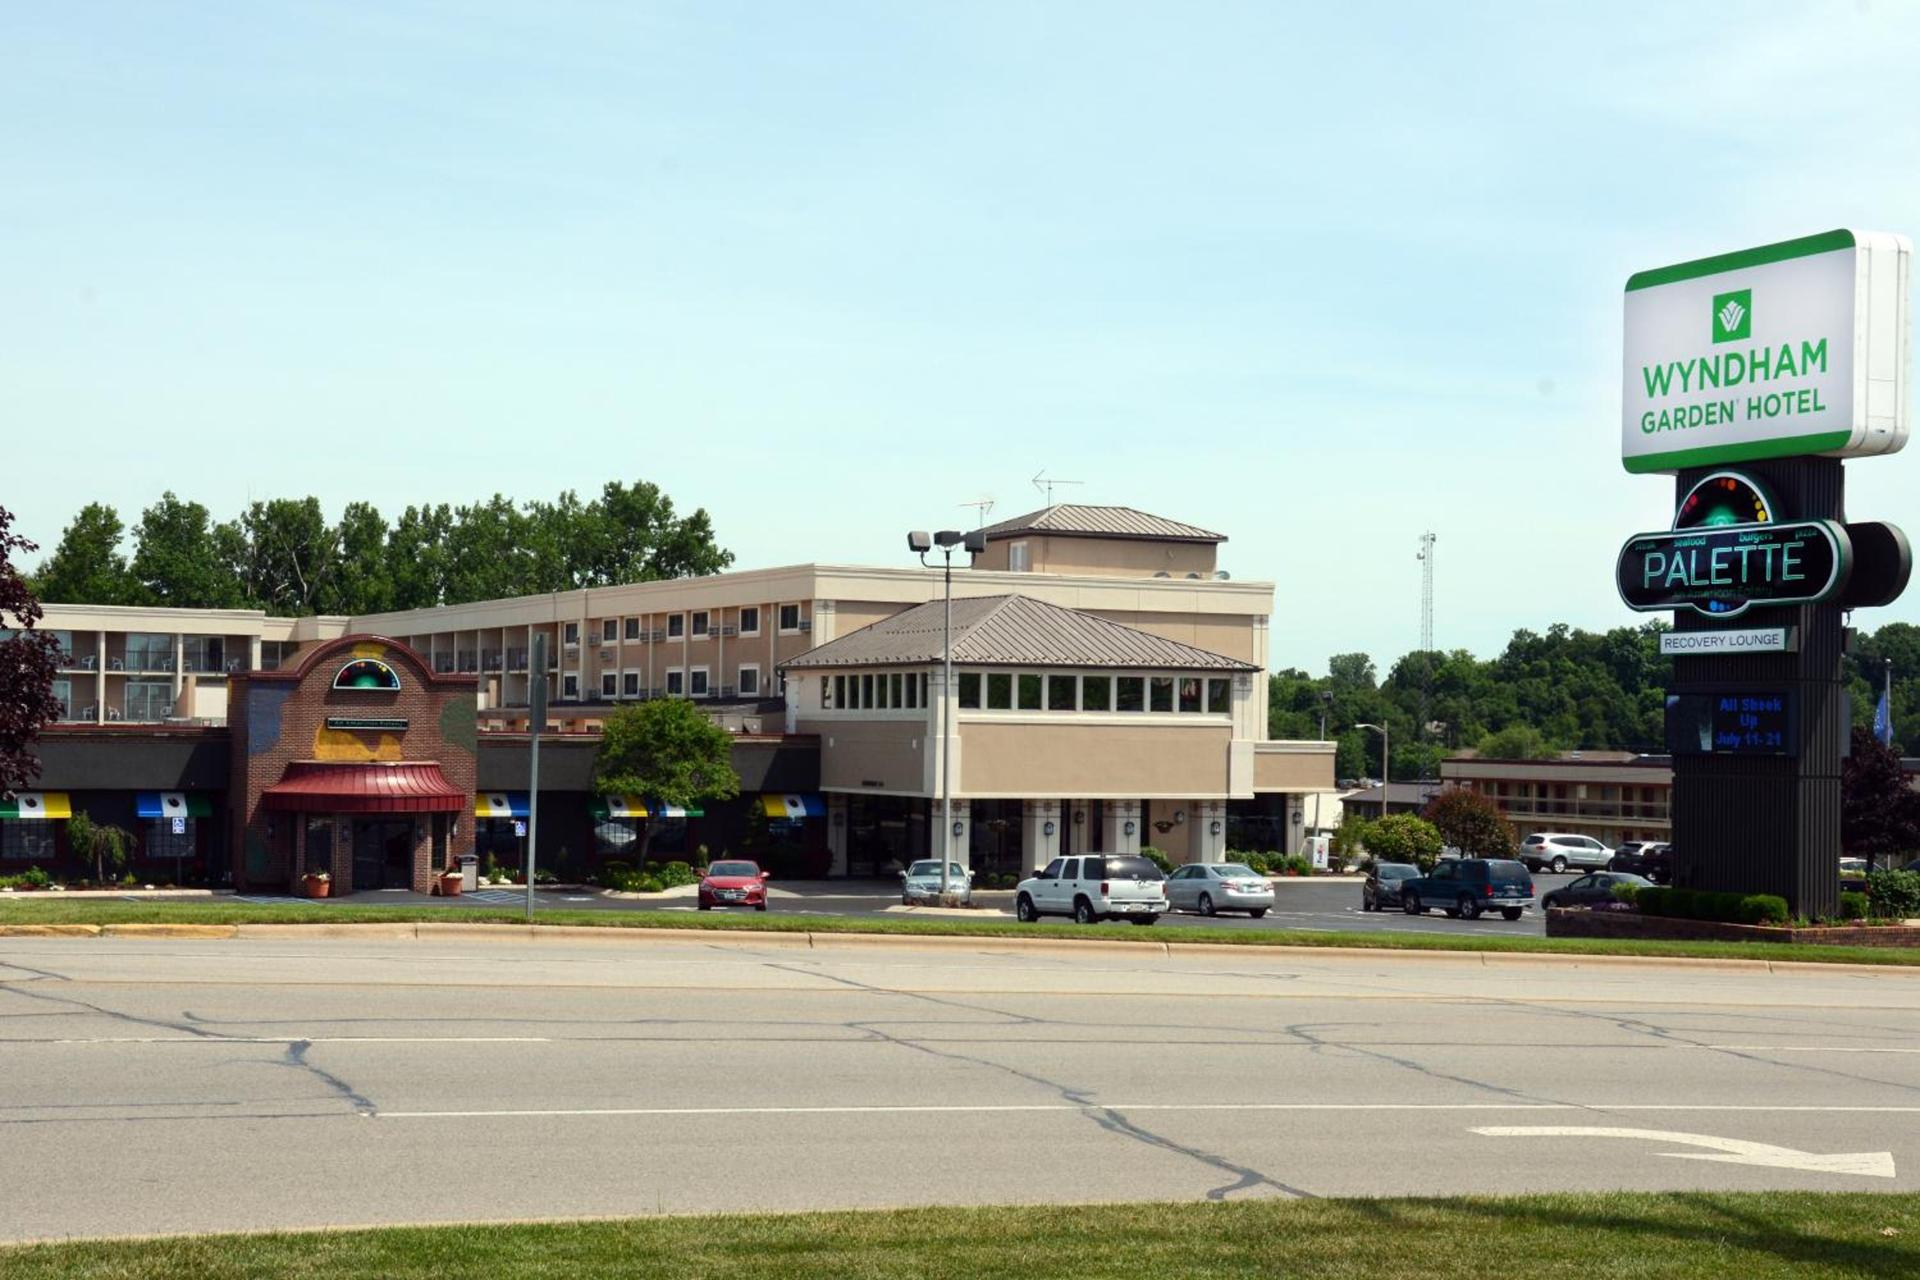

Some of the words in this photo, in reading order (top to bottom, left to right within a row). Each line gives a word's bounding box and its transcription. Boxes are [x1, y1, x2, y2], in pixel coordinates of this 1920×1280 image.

[1643, 337, 1827, 398] WYNDHAM
[1641, 400, 1735, 434] GARDEN
[1747, 388, 1826, 420] HOTEL
[1673, 535, 1706, 548] seafood
[1739, 530, 1773, 544] burgers
[1644, 541, 1806, 589] PALETTE
[1664, 636, 1726, 649] RECOVERY
[1730, 633, 1780, 646] LOUNGE
[1719, 696, 1738, 712] All
[1739, 713, 1759, 731] Up
[1715, 731, 1741, 748] July
